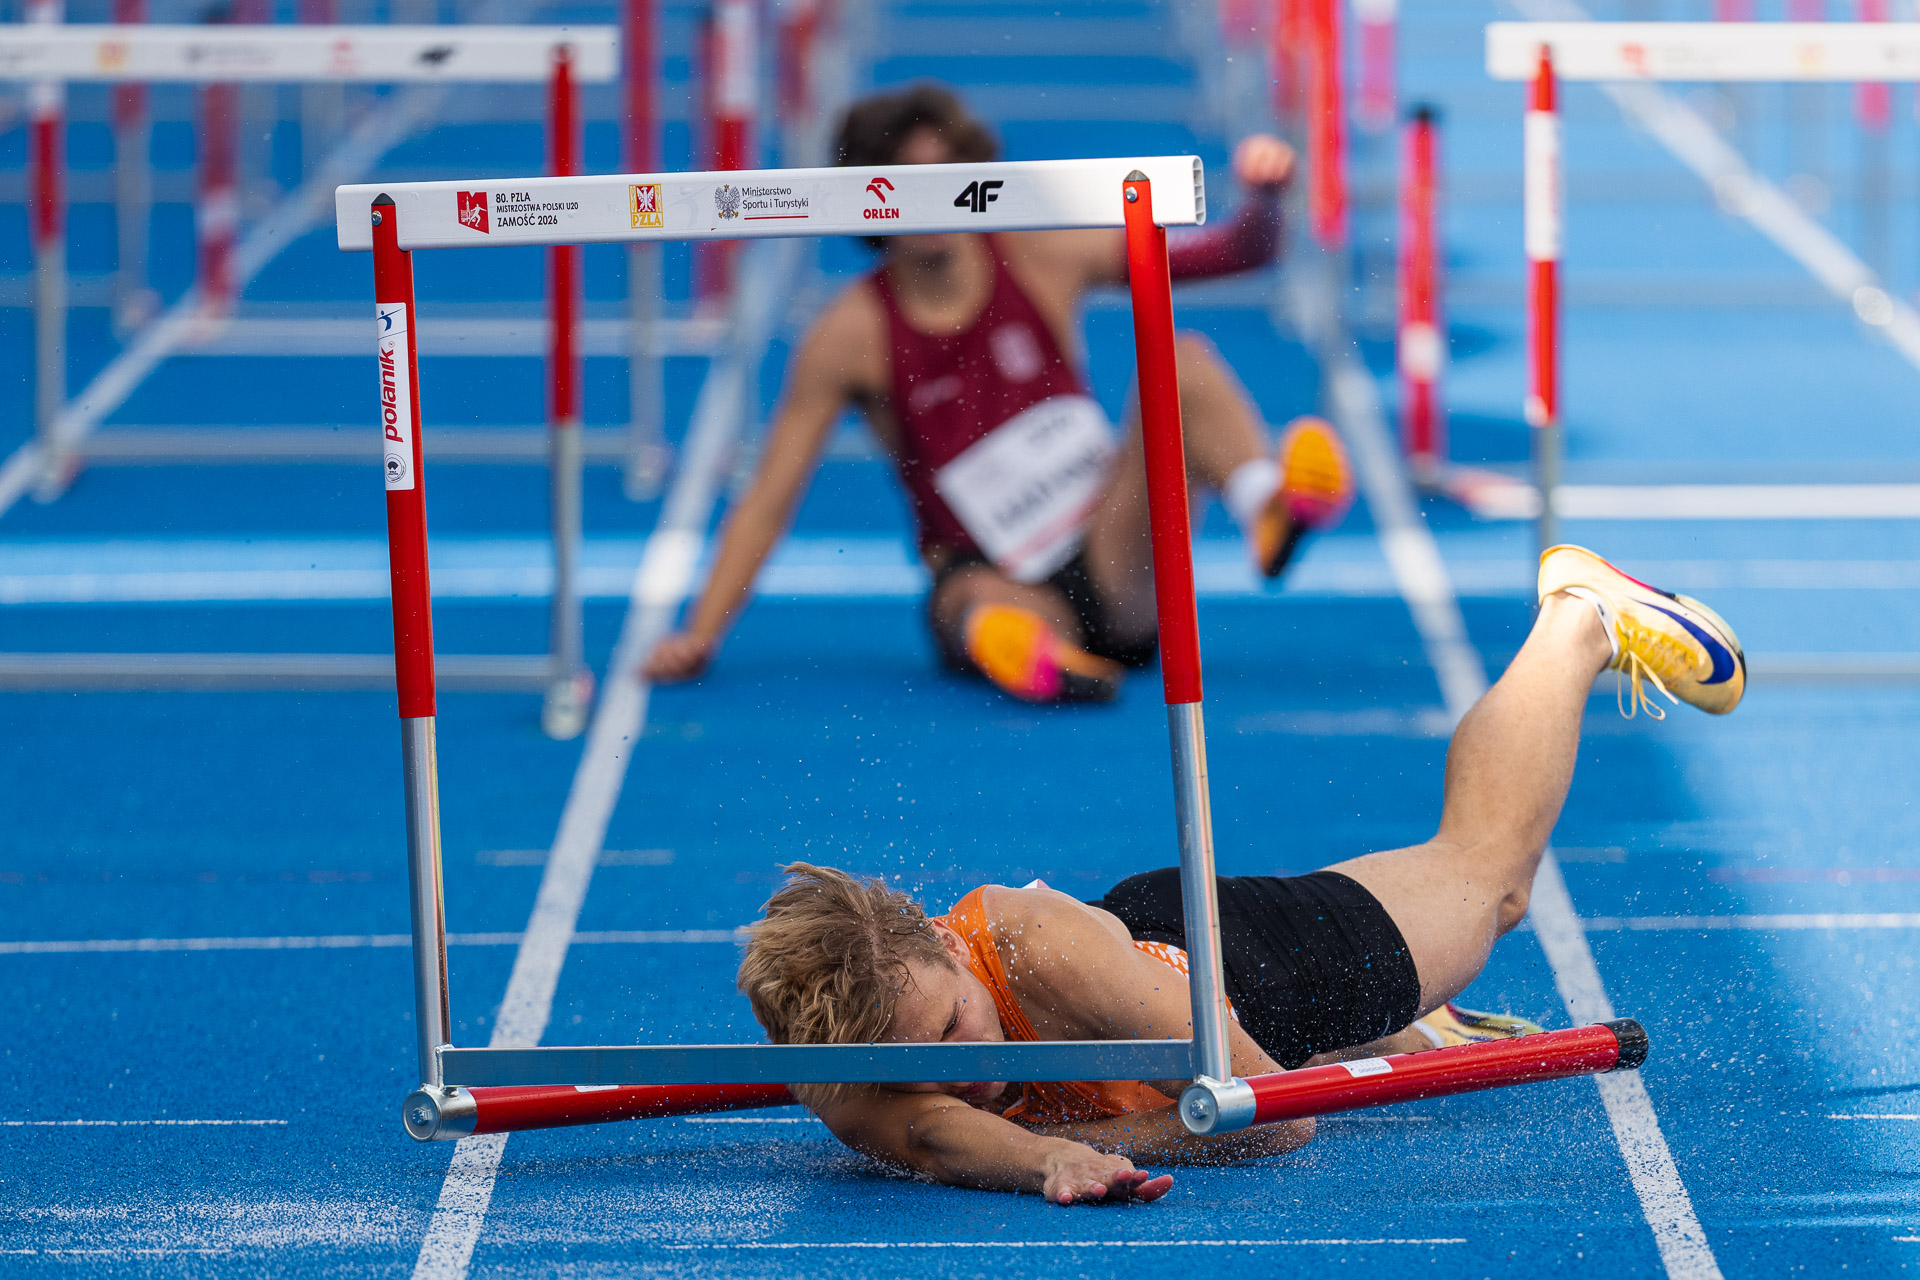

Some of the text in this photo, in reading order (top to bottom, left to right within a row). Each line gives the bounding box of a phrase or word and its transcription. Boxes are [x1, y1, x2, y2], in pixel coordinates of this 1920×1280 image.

[495, 192, 531, 203] 80. PZLA
[741, 187, 792, 197] Ministerstwo
[953, 180, 1004, 213] 4F
[496, 202, 579, 213] MISTRZOSTWA POLSKI U20
[742, 197, 809, 210] Sportu i Turystyki
[497, 213, 558, 227] ZAMOŚĆ 2026
[632, 213, 662, 227] PZLA
[863, 208, 900, 219] ORLEN
[379, 346, 404, 443] polanik
